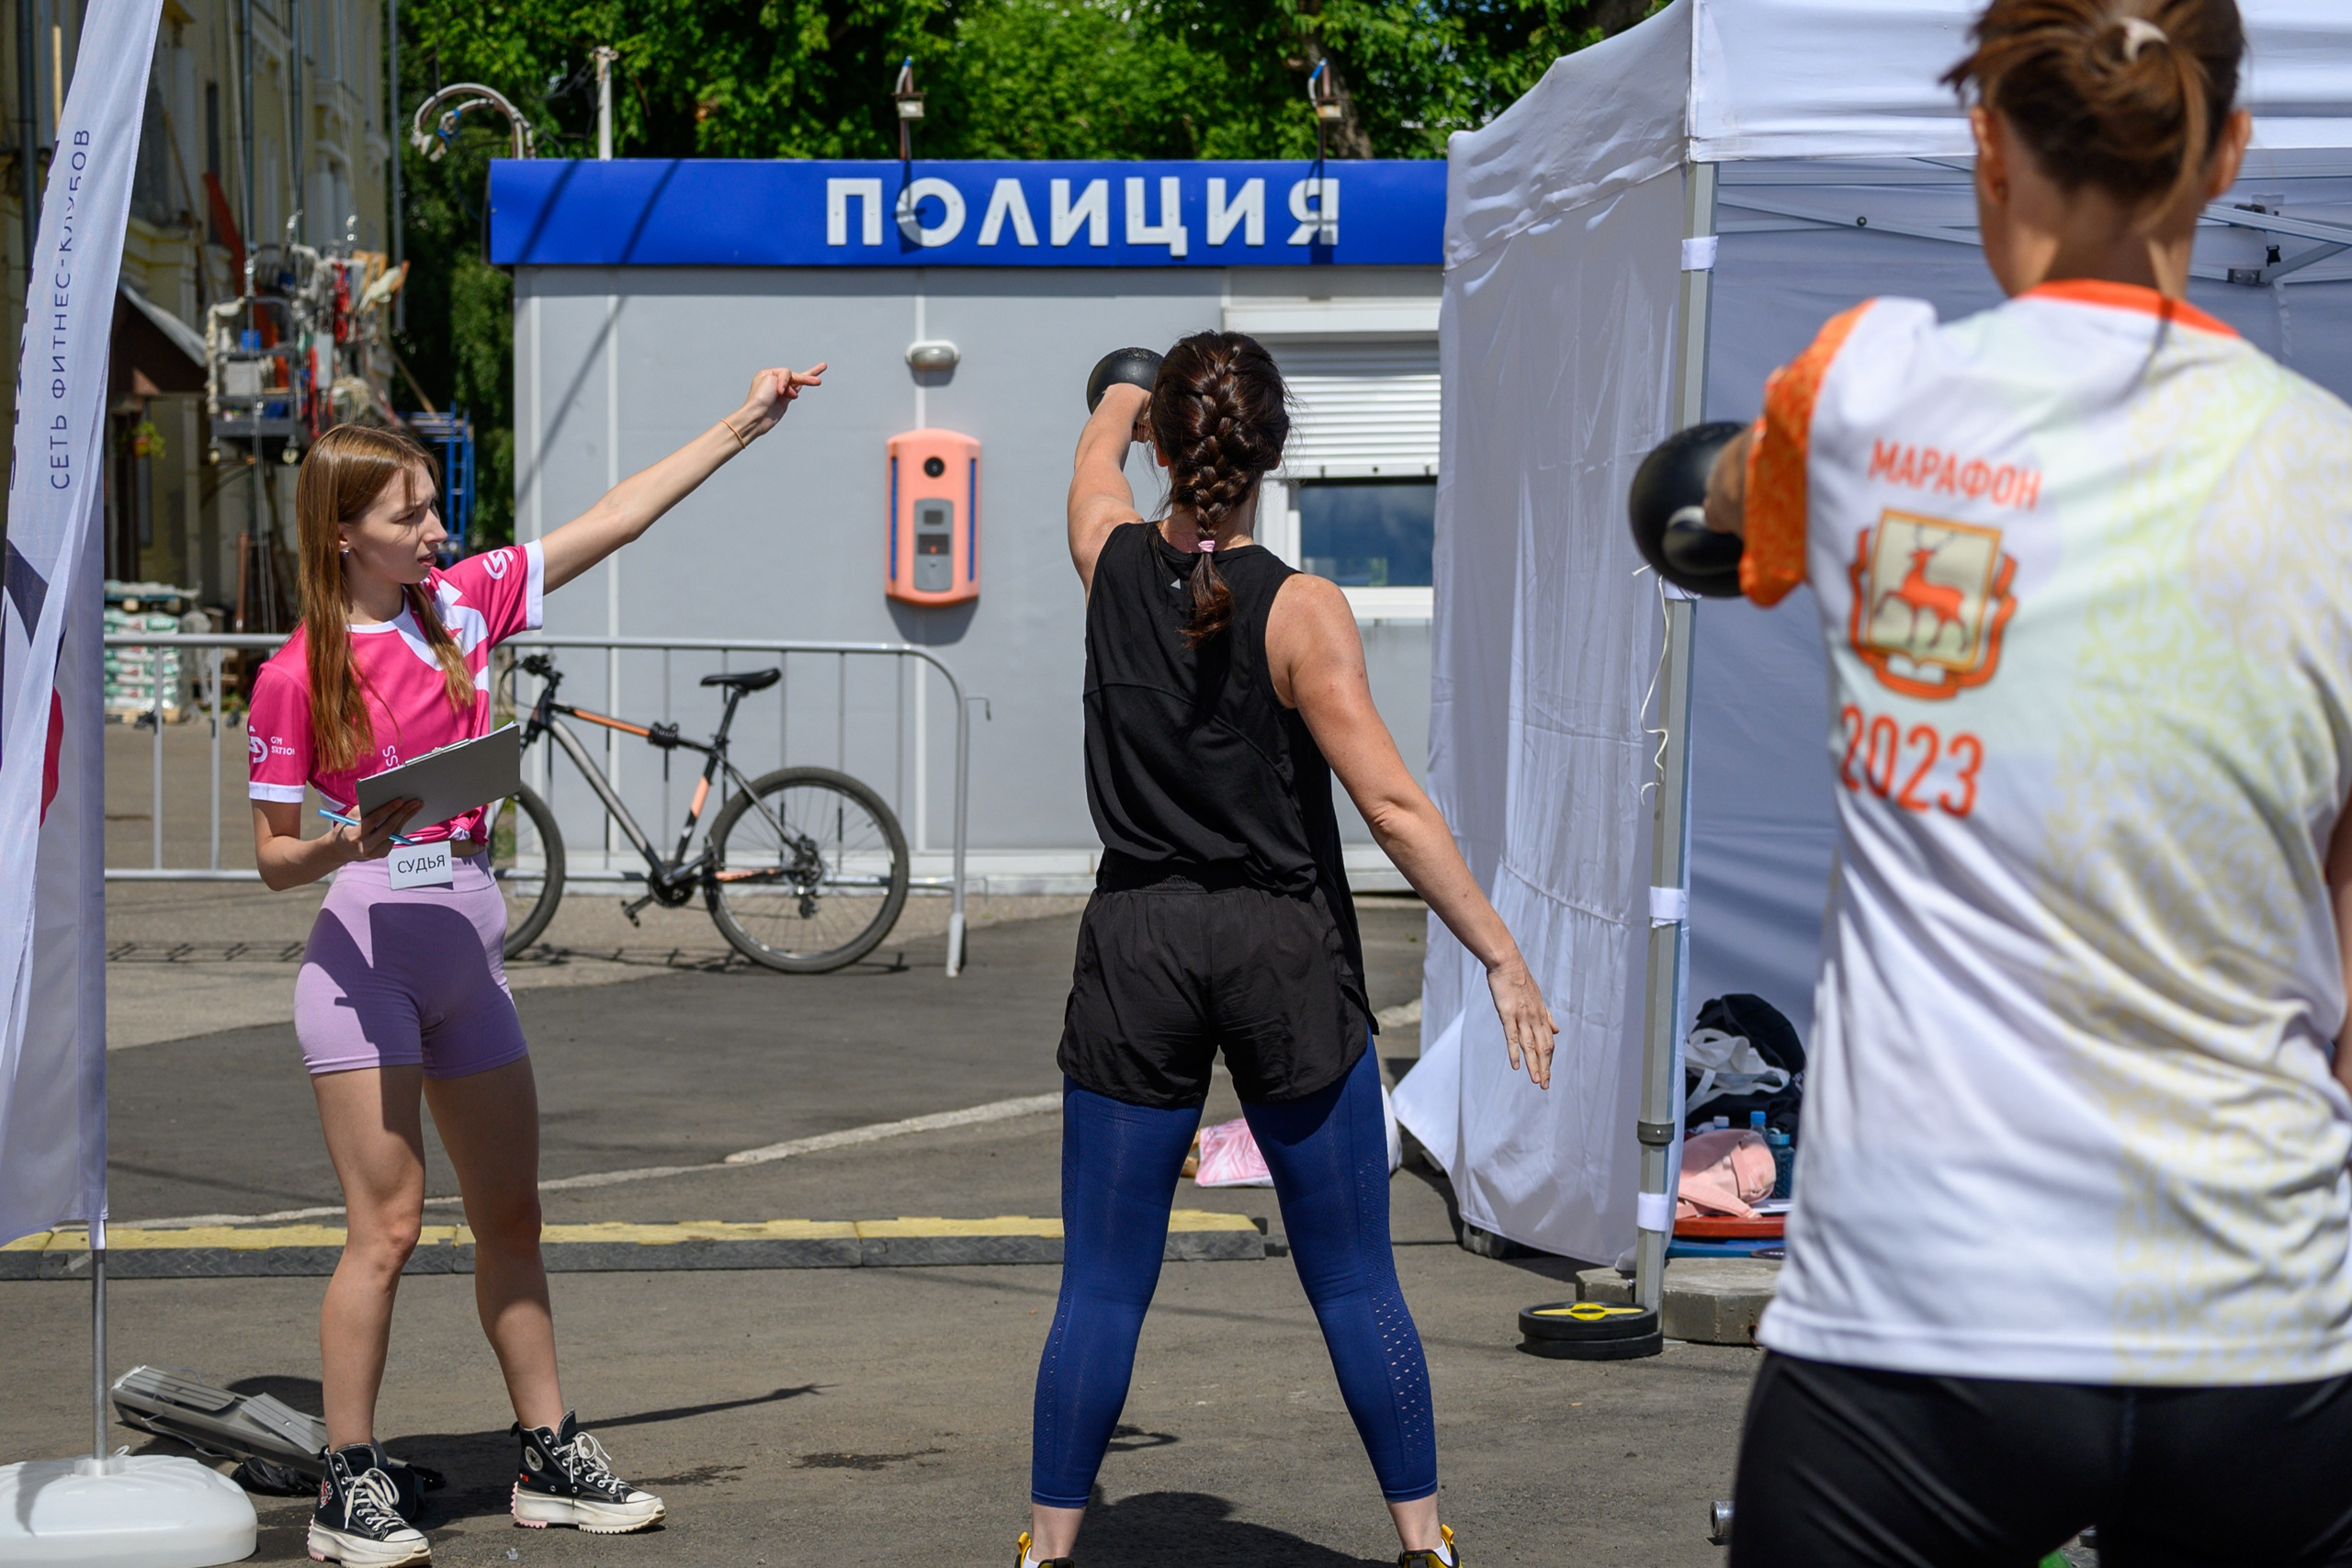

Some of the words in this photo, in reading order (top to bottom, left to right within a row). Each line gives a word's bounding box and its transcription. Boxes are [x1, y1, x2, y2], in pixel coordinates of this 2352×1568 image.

[828, 177, 1340, 256] ПОЛИЦИЯ
[50, 414, 71, 490] СЕТЬ
[1868, 436, 2043, 512] МАРАФОН
[1839, 703, 1984, 818] 2023
[397, 854, 446, 874] СУДЬЯ
